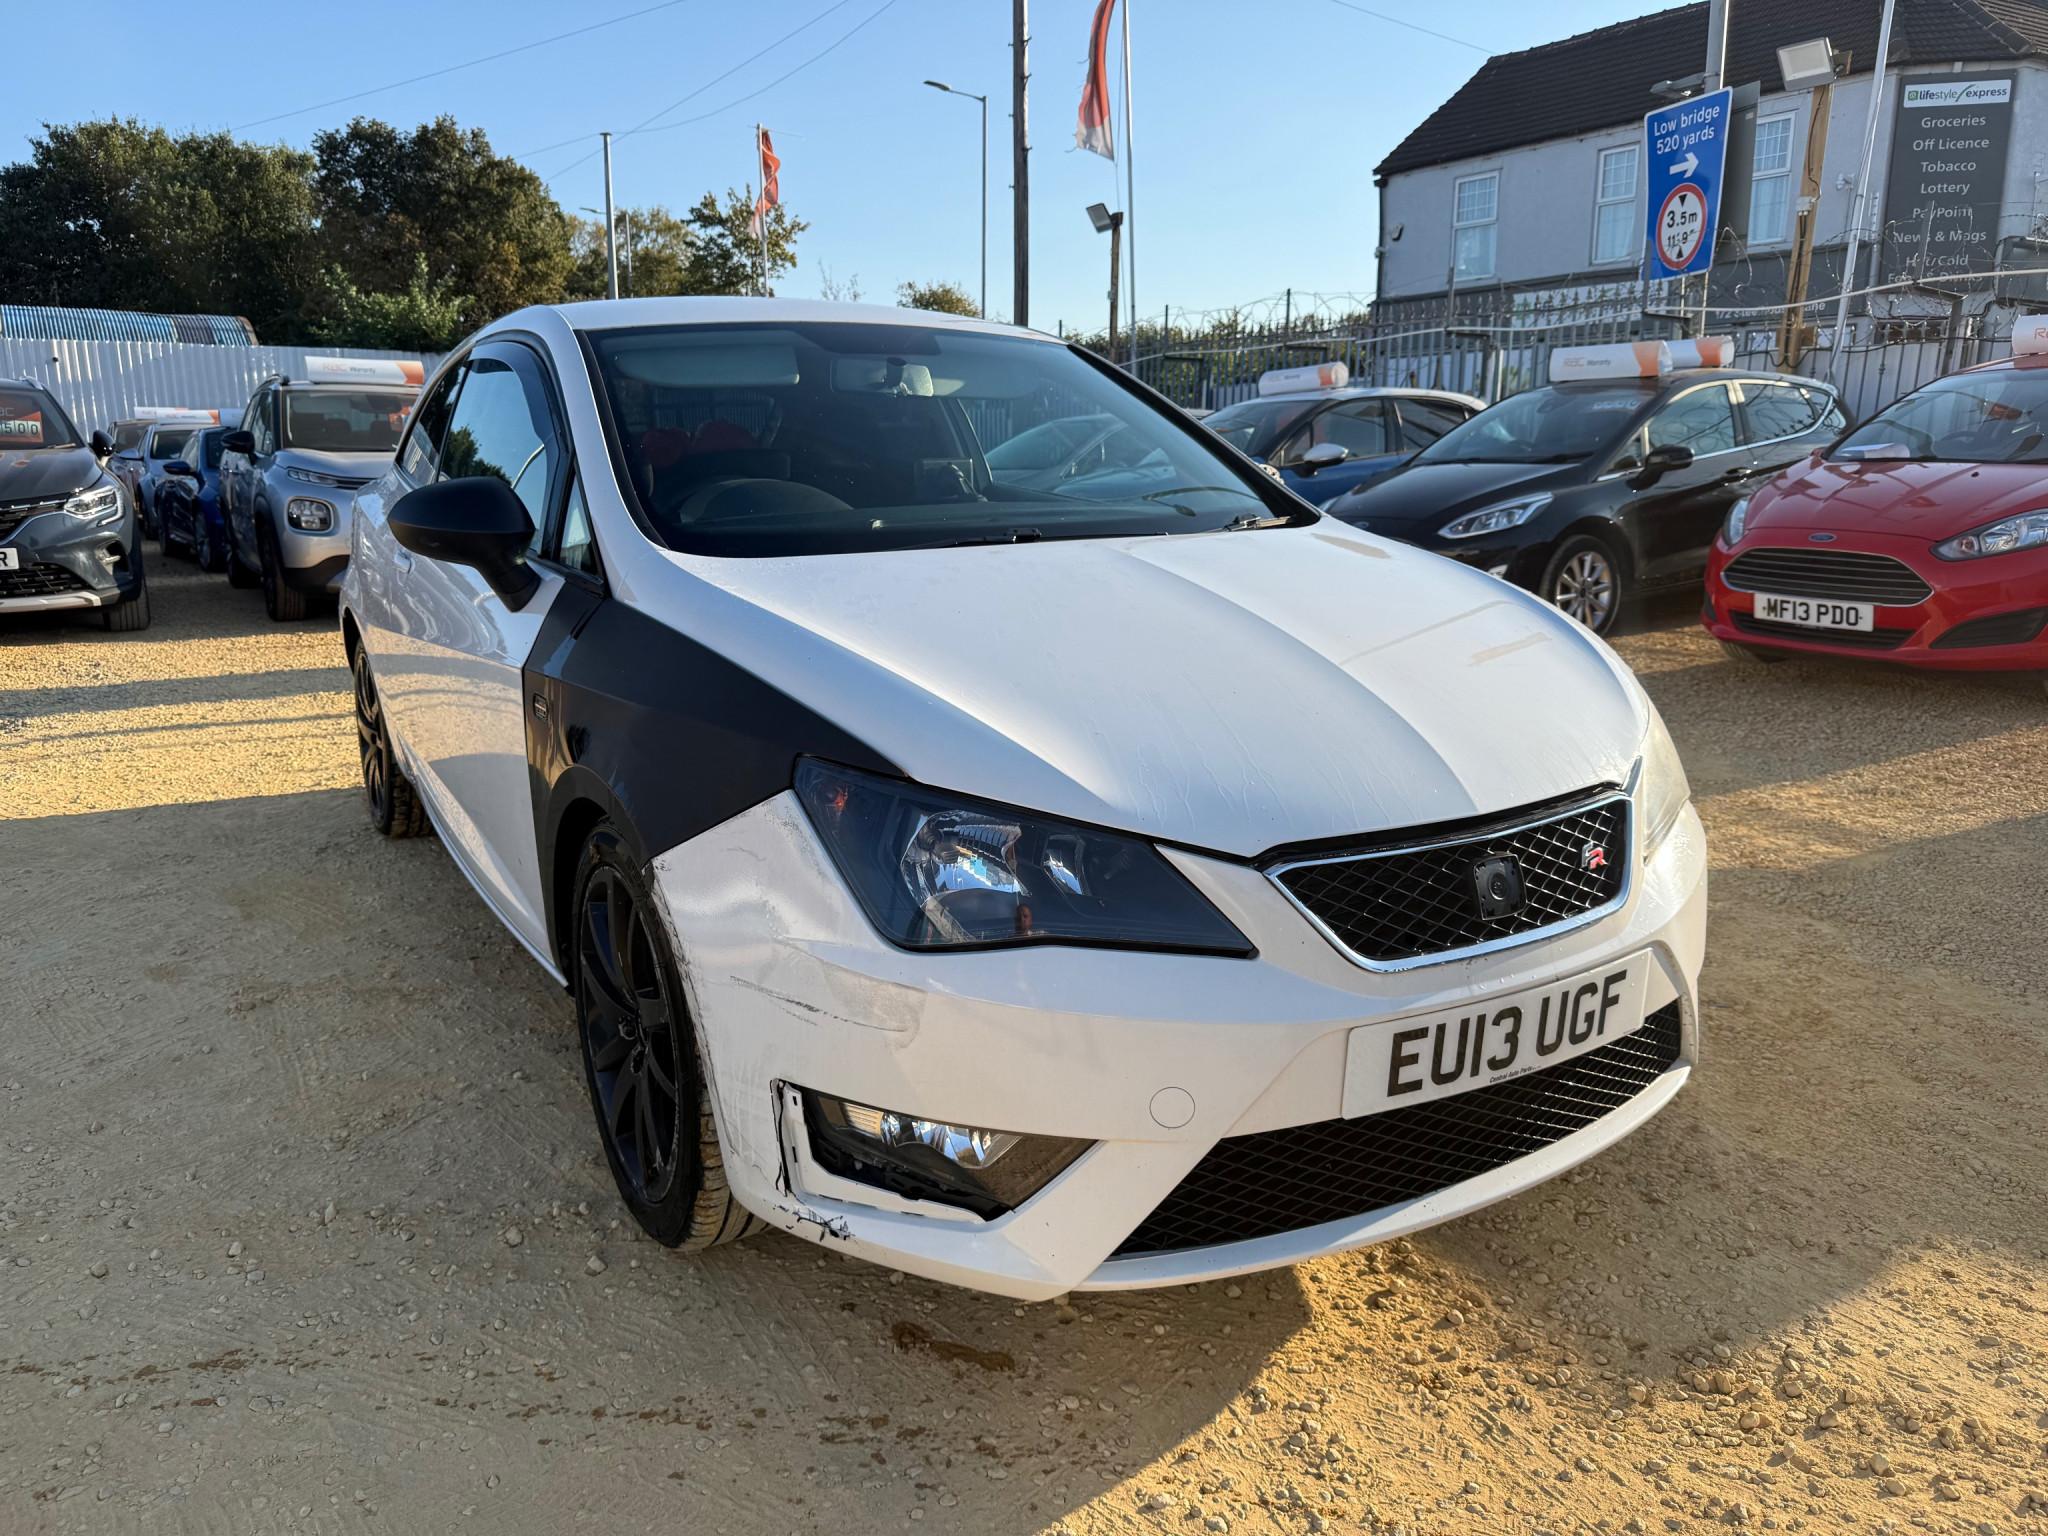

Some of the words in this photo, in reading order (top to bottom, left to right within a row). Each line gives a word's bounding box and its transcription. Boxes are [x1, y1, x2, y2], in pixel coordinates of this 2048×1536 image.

[1919, 89, 1958, 102] lifestyle
[1965, 87, 2008, 99] express
[1654, 119, 1677, 137] Low
[1680, 104, 1720, 128] bridge
[1921, 114, 1987, 128] Groceries
[1656, 134, 1680, 155] 520
[1682, 125, 1715, 151] yards
[1912, 139, 1936, 151] Off
[1938, 137, 1990, 150] Licence
[1920, 160, 1977, 173] Tobacco
[1920, 182, 1971, 195] Lottery
[1666, 210, 1698, 228] 3.5m
[1935, 231, 1945, 242] &
[1949, 230, 1987, 244] Mags
[1905, 254, 1969, 267] Ht/Cold
[1766, 598, 1810, 621] MF13
[1816, 603, 1859, 626] PDO
[1387, 1005, 1522, 1097] EU13
[1535, 969, 1628, 1057] UGF
